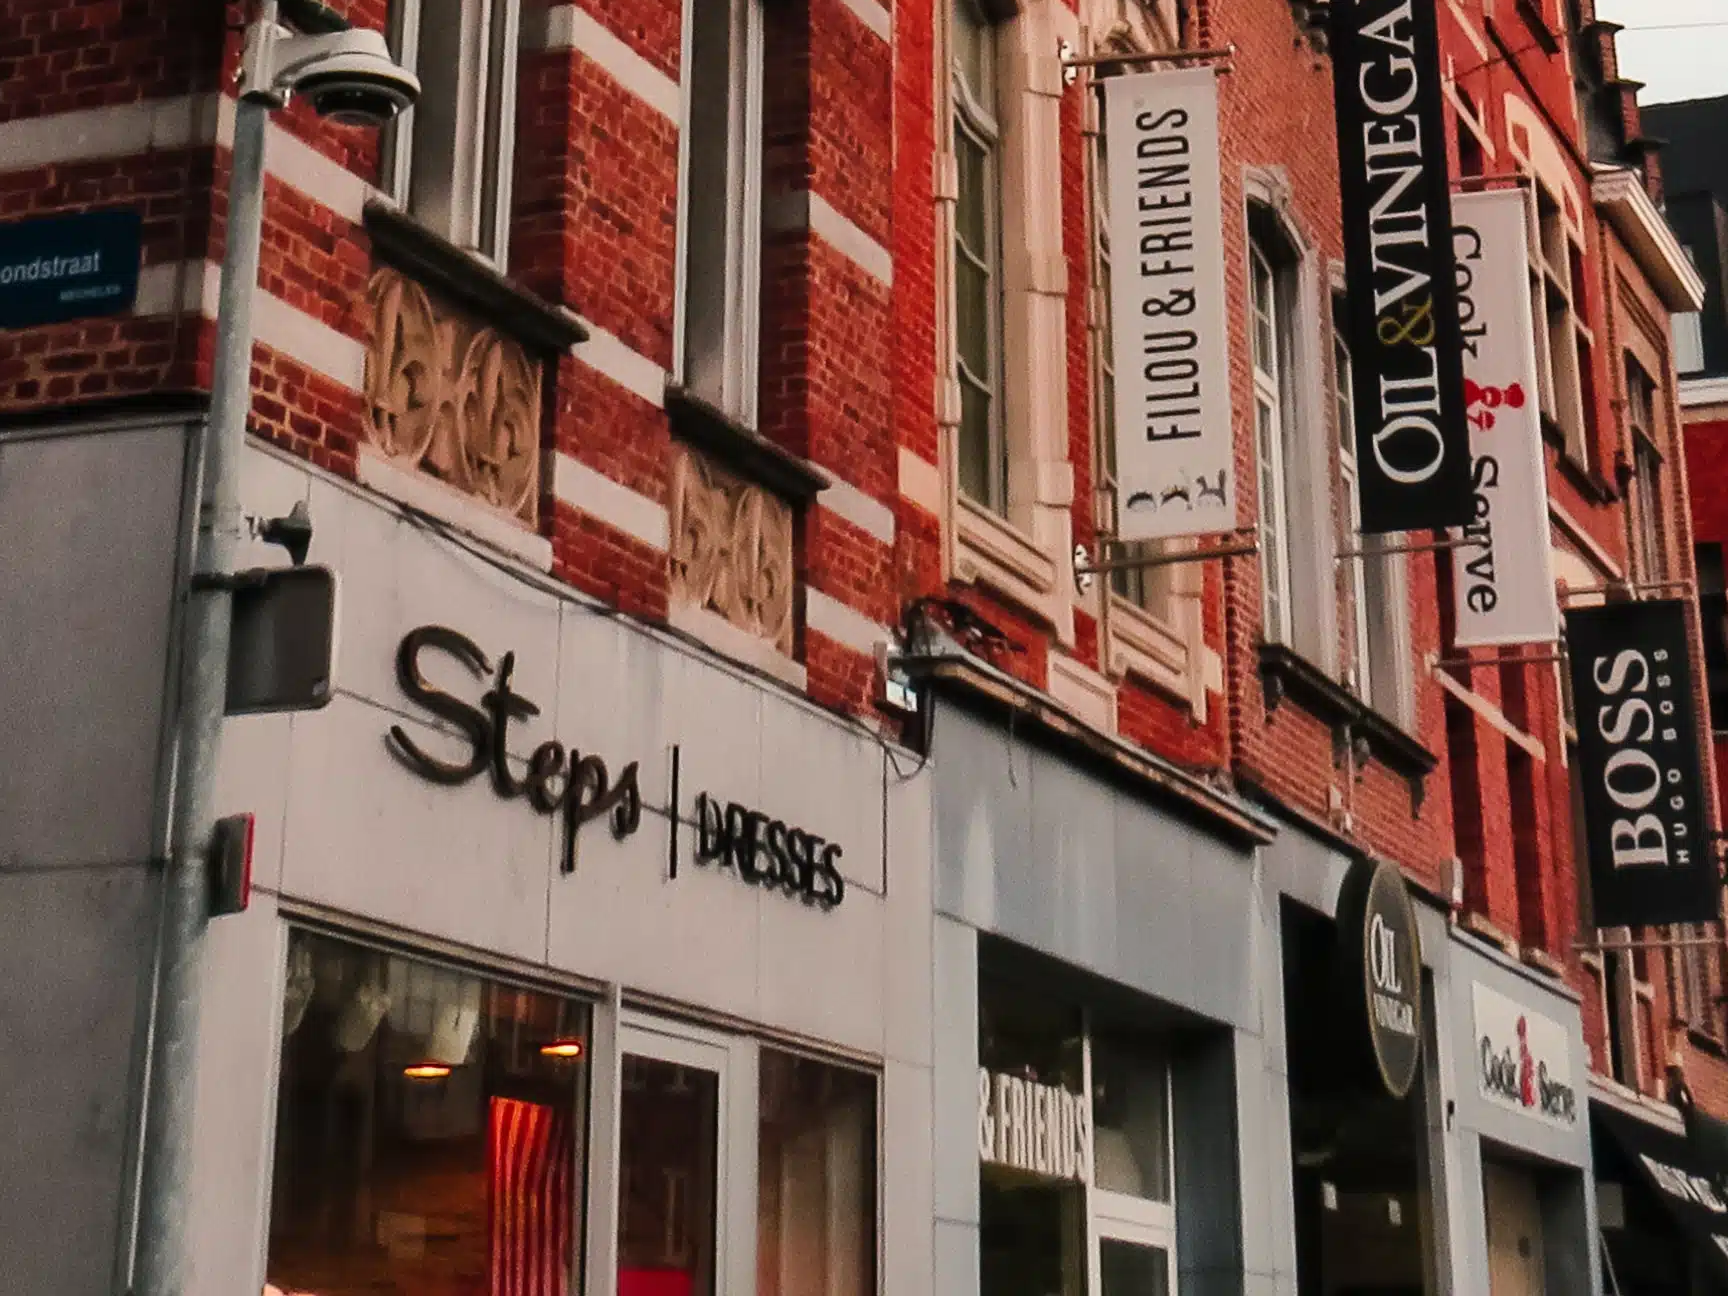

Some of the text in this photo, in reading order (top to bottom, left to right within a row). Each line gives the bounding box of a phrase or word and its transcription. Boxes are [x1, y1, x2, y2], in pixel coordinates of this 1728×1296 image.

[1135, 107, 1202, 442] FILOU & FRIENDS
[384, 623, 641, 875] Steps
[692, 791, 845, 909] DRESSES
[1593, 649, 1669, 869] BOSS
[1653, 648, 1690, 864] HUGO BOSS
